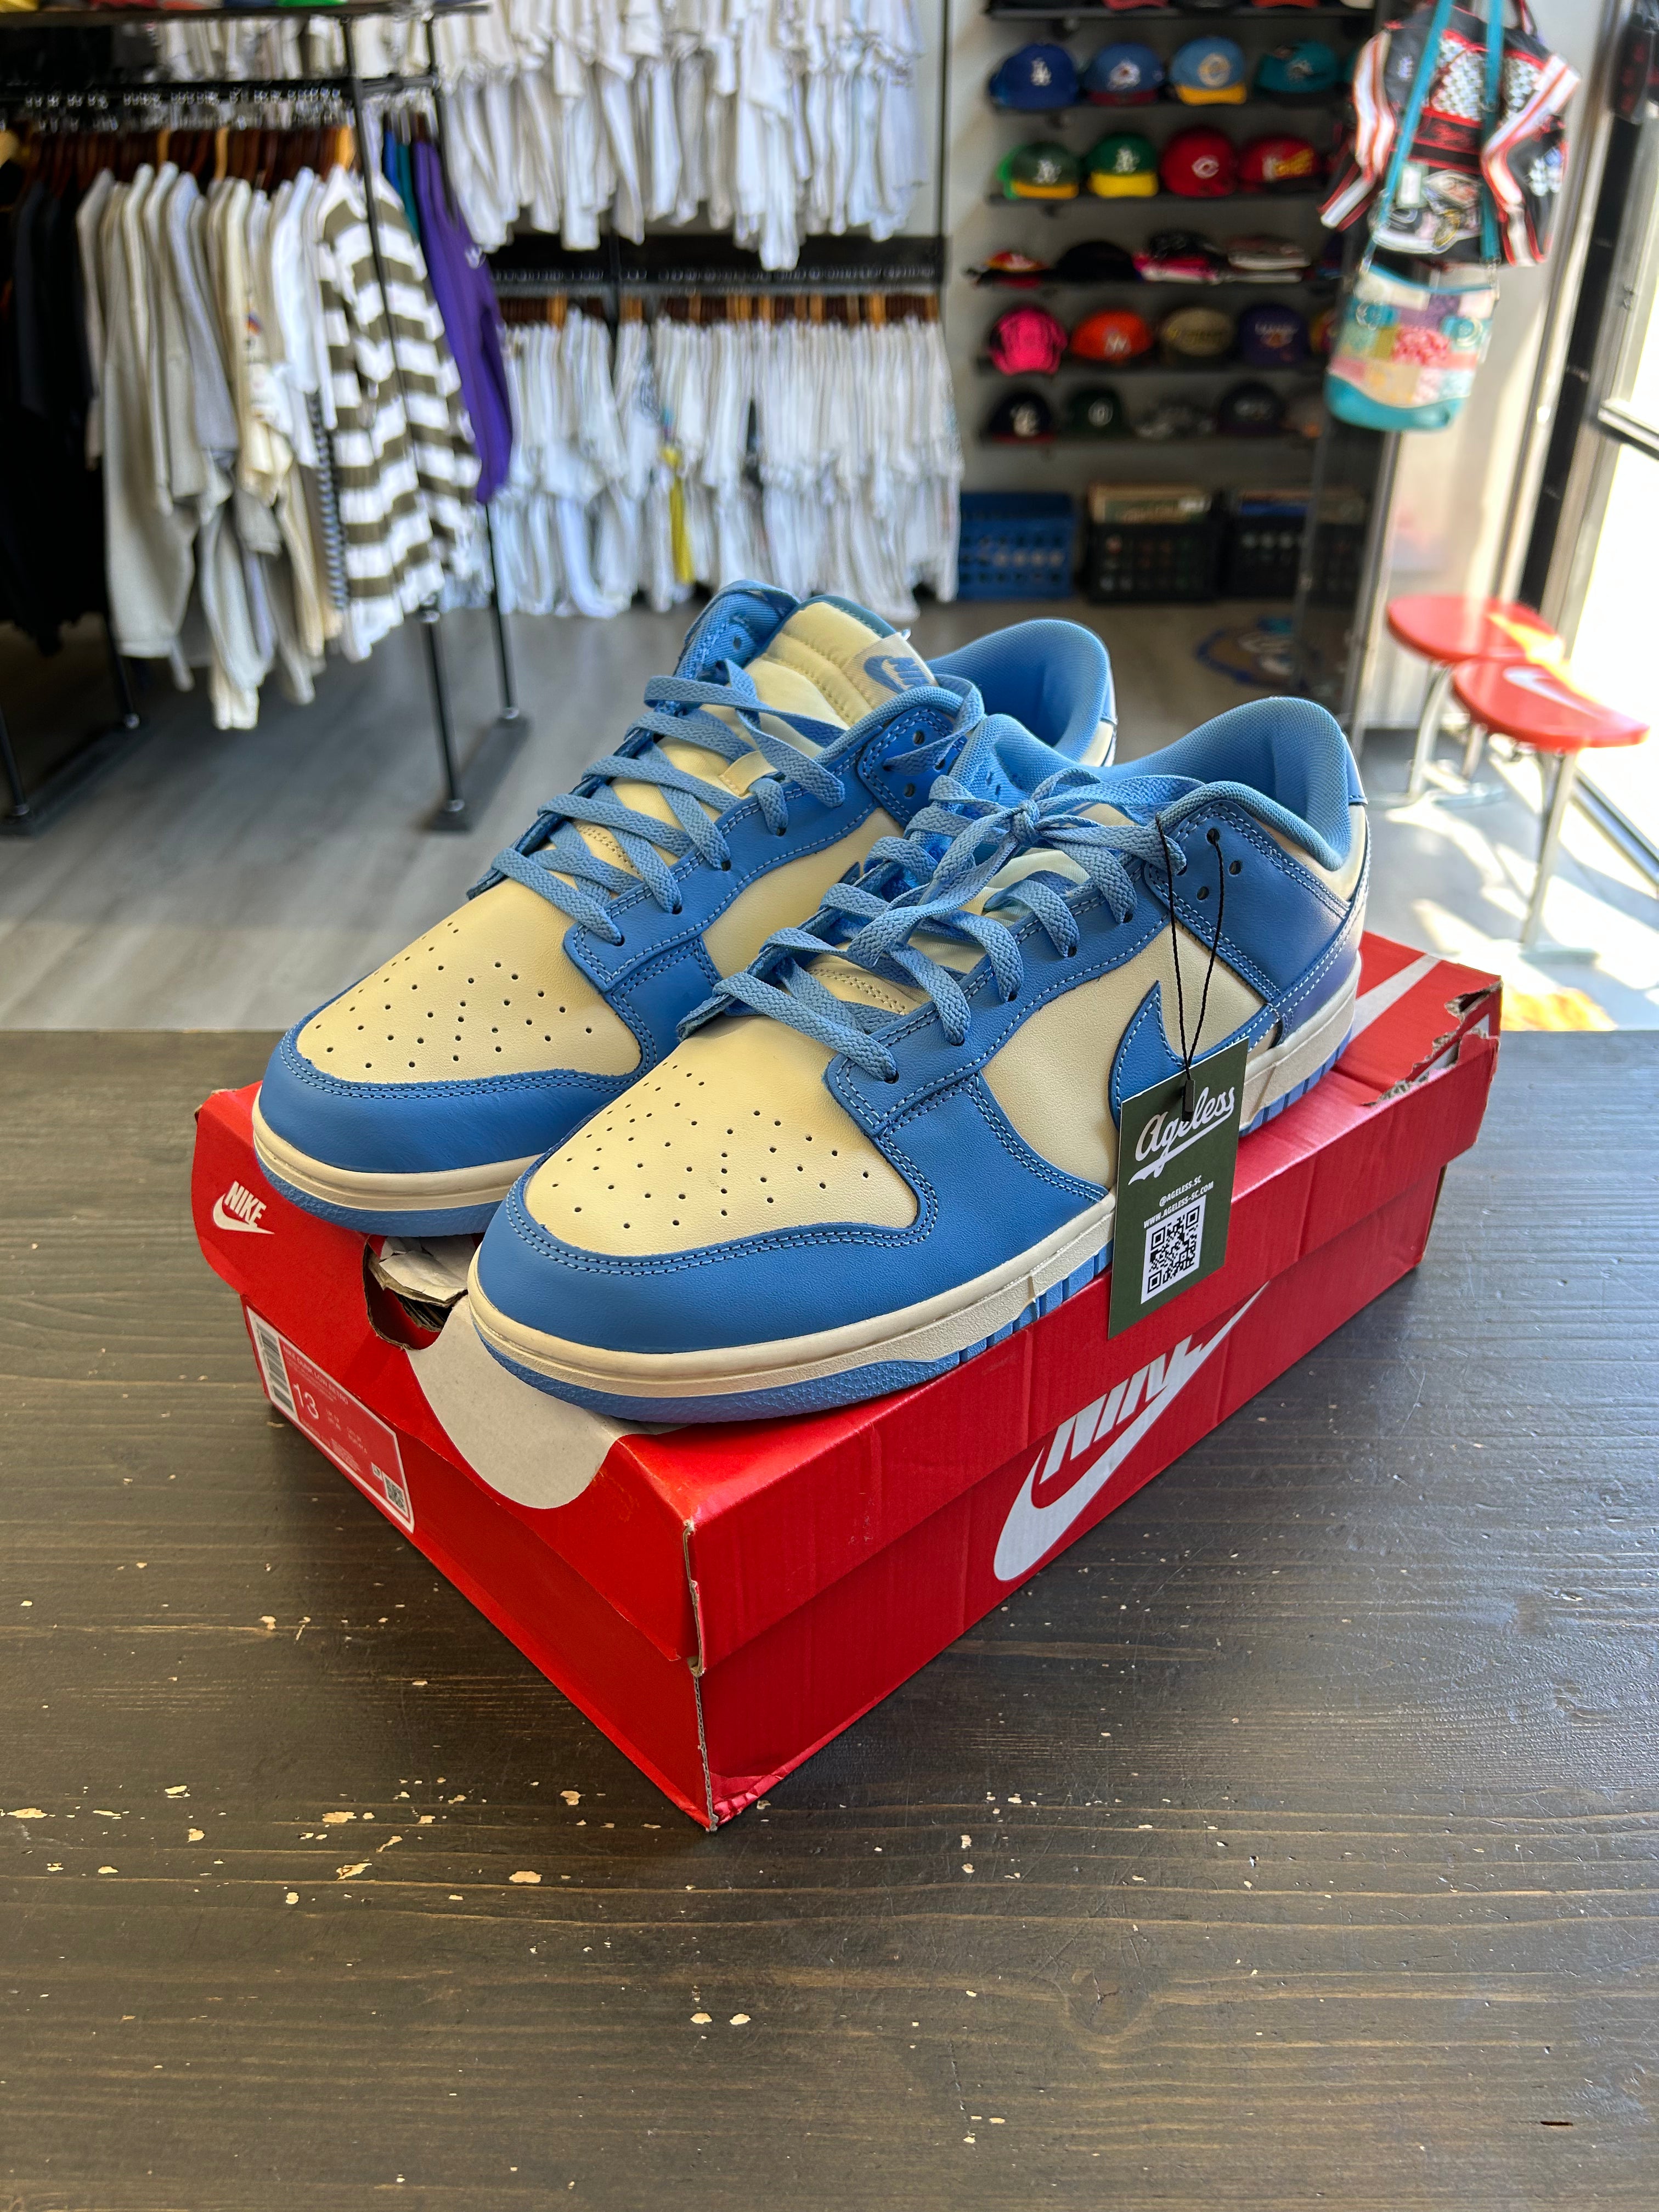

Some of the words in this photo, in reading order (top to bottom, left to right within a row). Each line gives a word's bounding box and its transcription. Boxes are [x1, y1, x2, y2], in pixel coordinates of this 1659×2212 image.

[888, 657, 931, 690] NIK
[1134, 1087, 1235, 1180] Ageless
[224, 1180, 267, 1227] NIKE
[1143, 1181, 1214, 1228] WWW.AGELESS-SC.COM
[1159, 1175, 1202, 1207] @AGELESS.SC
[292, 1383, 319, 1419] 13
